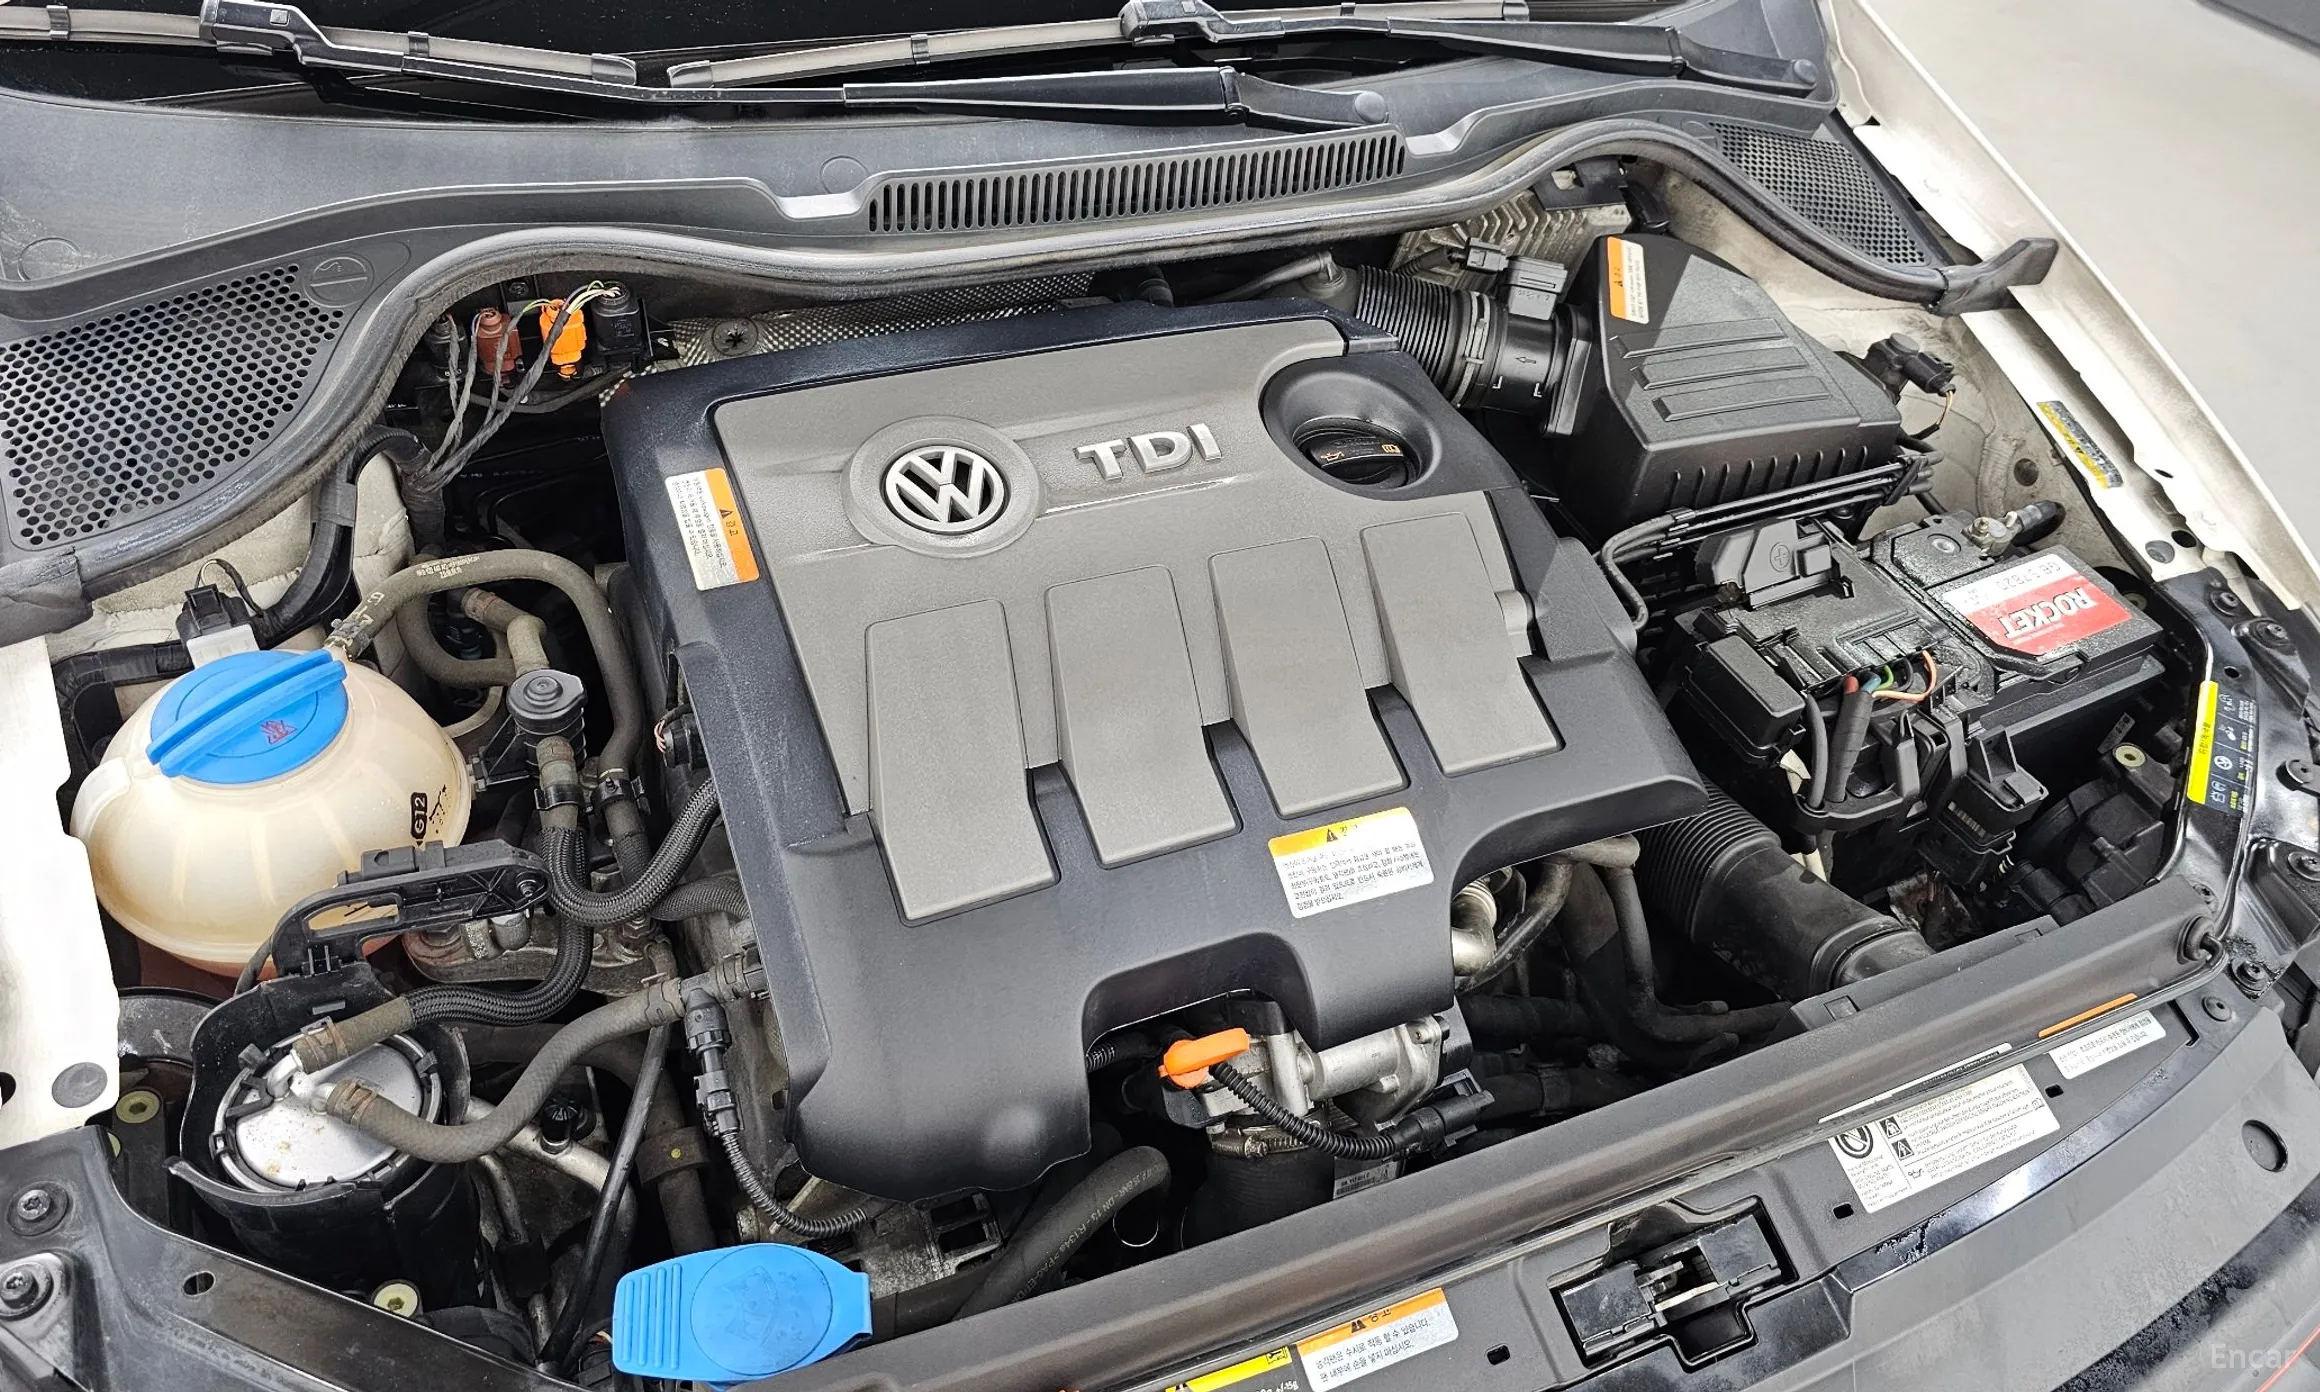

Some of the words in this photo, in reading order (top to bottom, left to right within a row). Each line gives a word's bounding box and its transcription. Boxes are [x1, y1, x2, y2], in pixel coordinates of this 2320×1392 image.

[1074, 422, 1223, 482] TDI
[1998, 587, 2095, 638] ROCKET
[414, 795, 426, 835] G12
